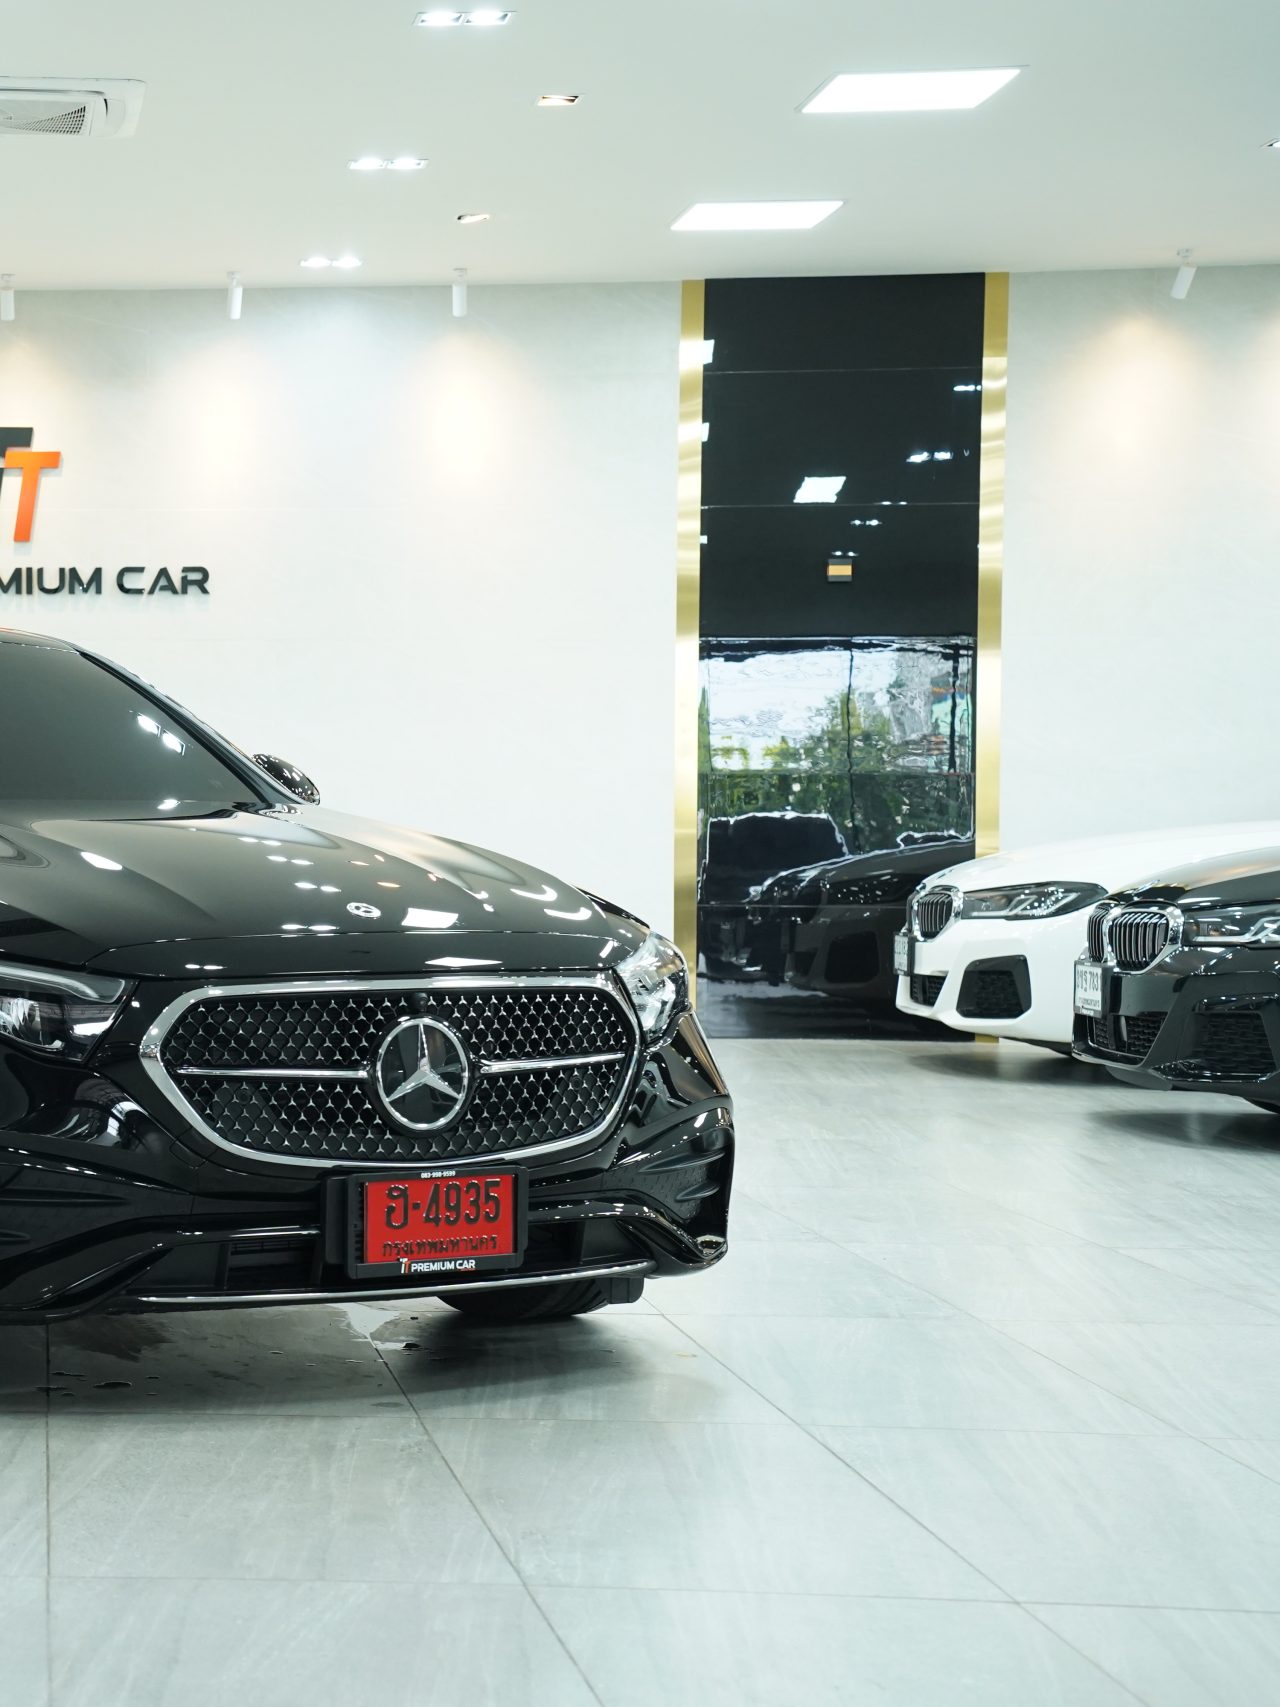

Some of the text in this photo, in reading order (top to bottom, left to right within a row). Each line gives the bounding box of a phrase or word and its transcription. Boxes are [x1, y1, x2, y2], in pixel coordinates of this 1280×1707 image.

[116, 566, 210, 595] CAR
[382, 1234, 498, 1257] กรุงเทพมหานคร
[411, 1260, 455, 1272] PREMIUM
[455, 1259, 476, 1270] CAR
